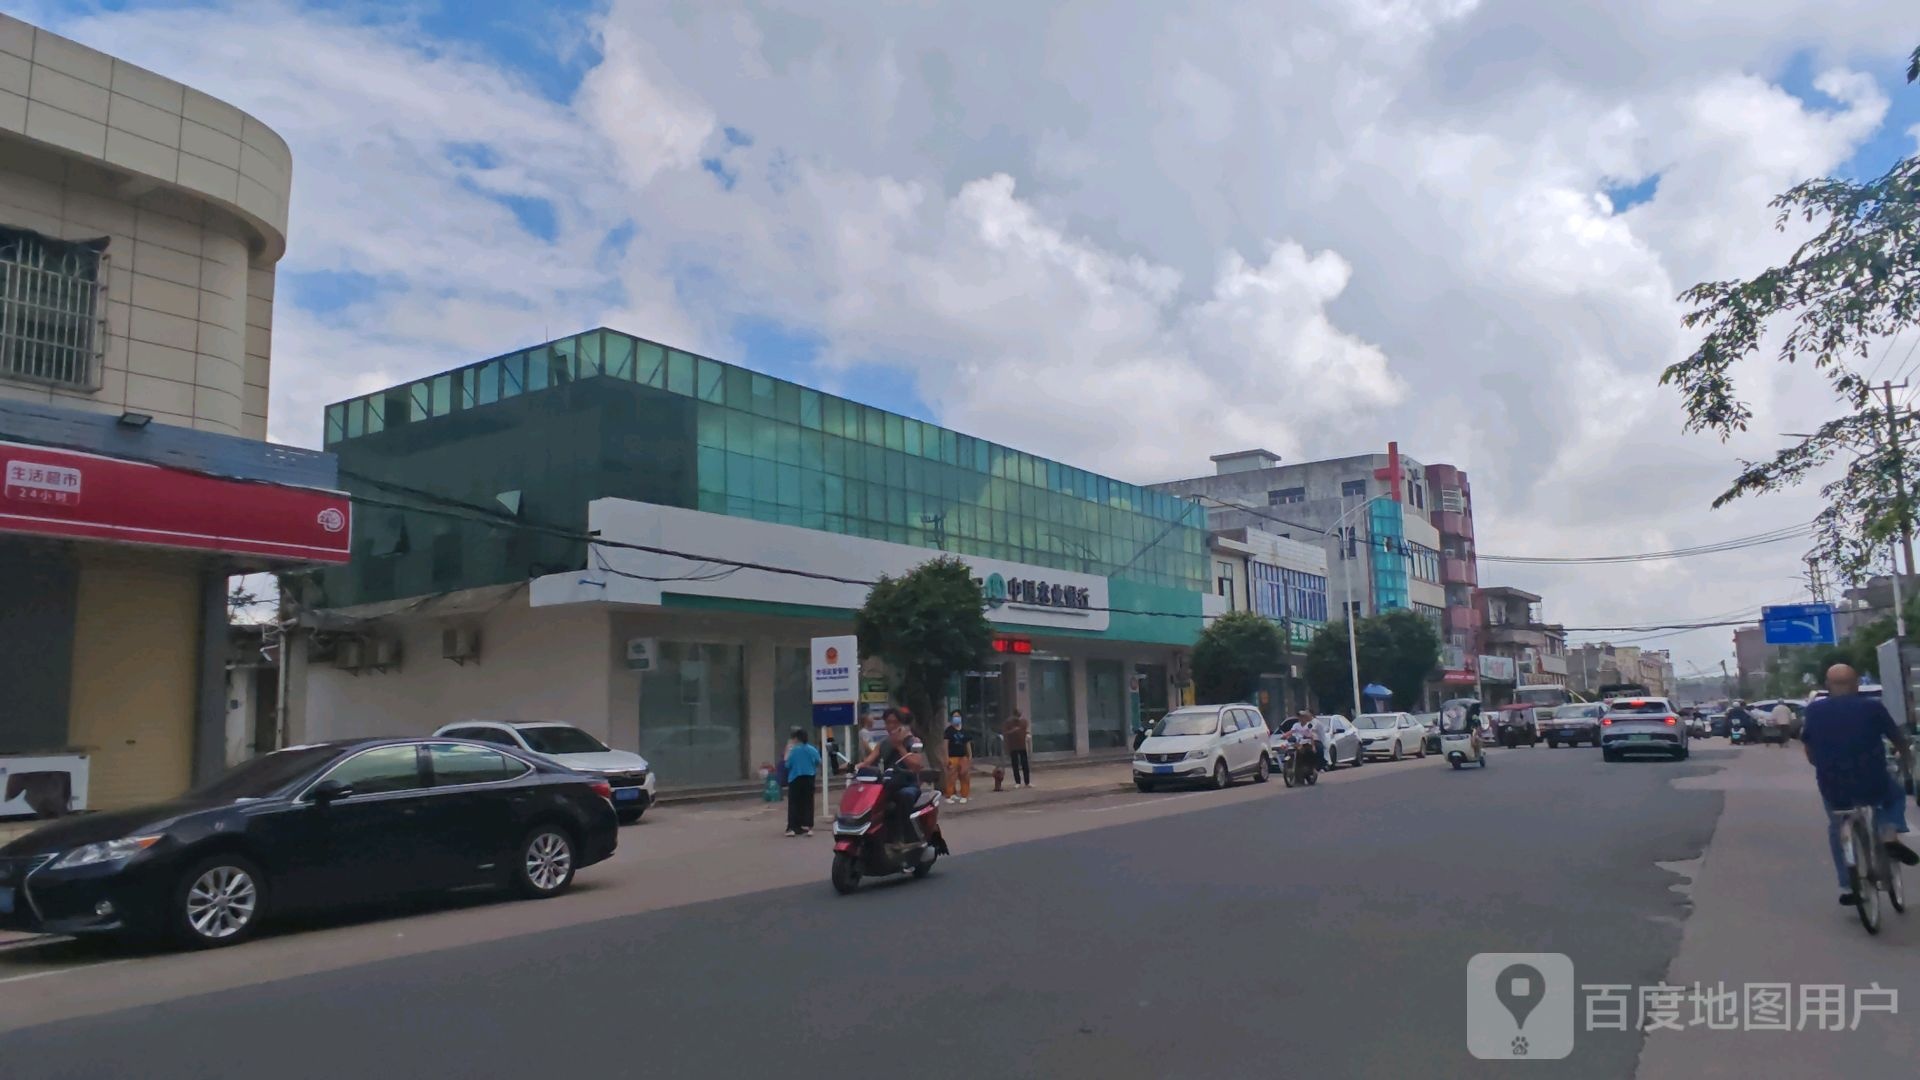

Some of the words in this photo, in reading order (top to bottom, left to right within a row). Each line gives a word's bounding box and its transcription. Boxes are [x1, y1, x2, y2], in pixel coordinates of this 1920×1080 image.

[11, 467, 77, 487] 生活超市
[1007, 576, 1090, 609] 中国农业银行
